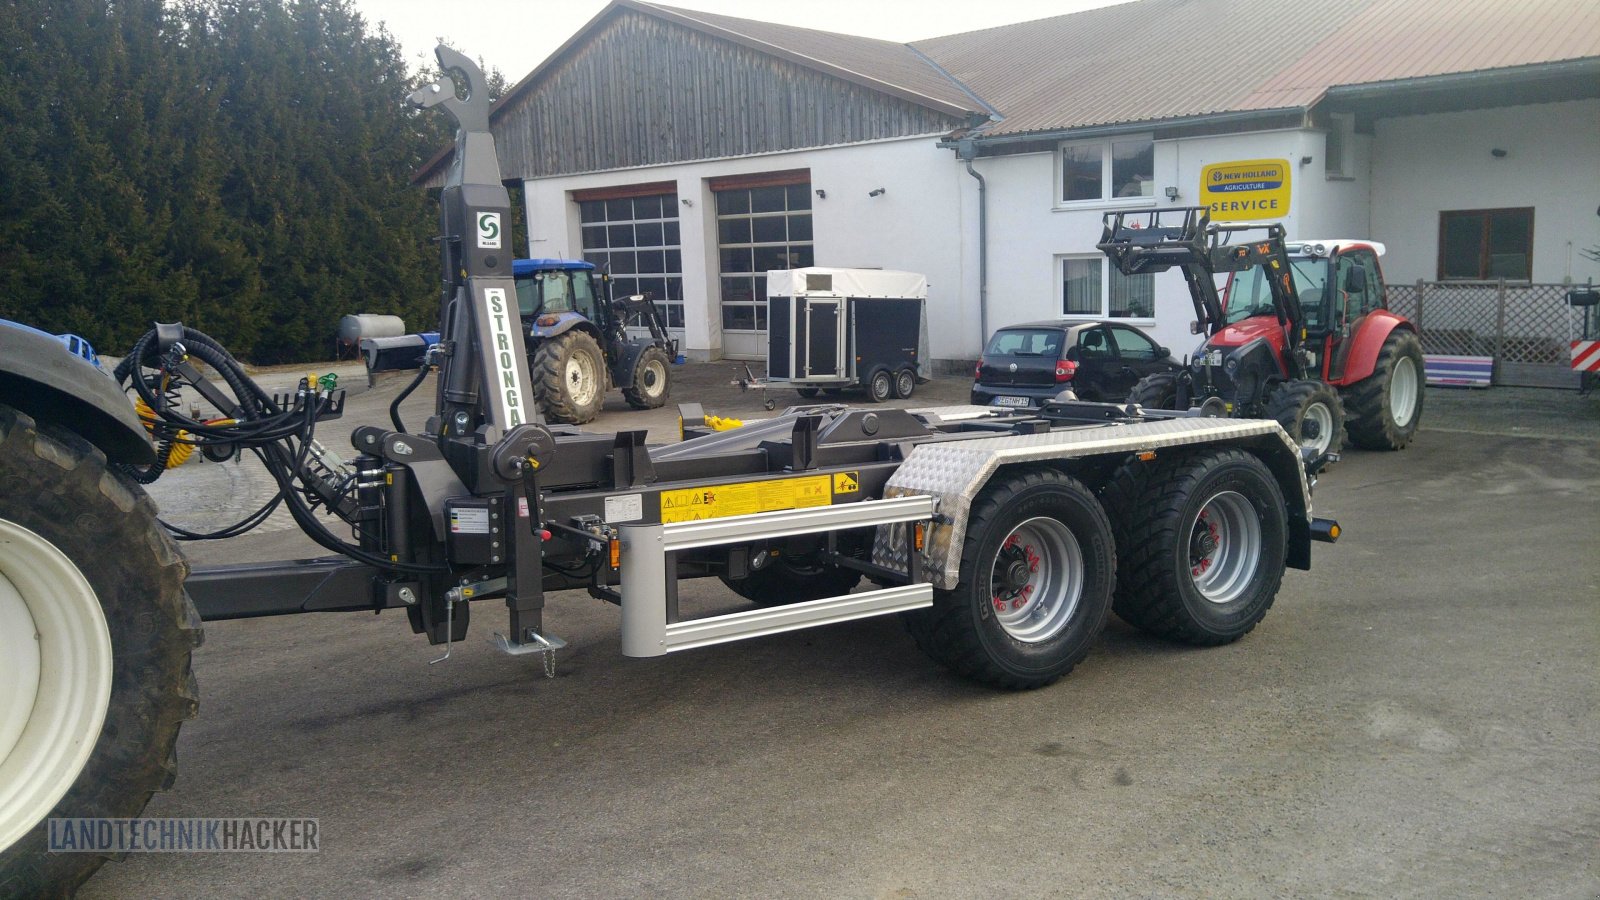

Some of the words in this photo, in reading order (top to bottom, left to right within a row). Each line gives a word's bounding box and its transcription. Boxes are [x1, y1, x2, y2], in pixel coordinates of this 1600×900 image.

[1224, 172, 1241, 180] NEW
[1242, 170, 1277, 178] HOLLAND
[1224, 182, 1265, 191] AGRICULTURE
[1211, 199, 1278, 212] SERVICE
[490, 295, 522, 428] STRONGA
